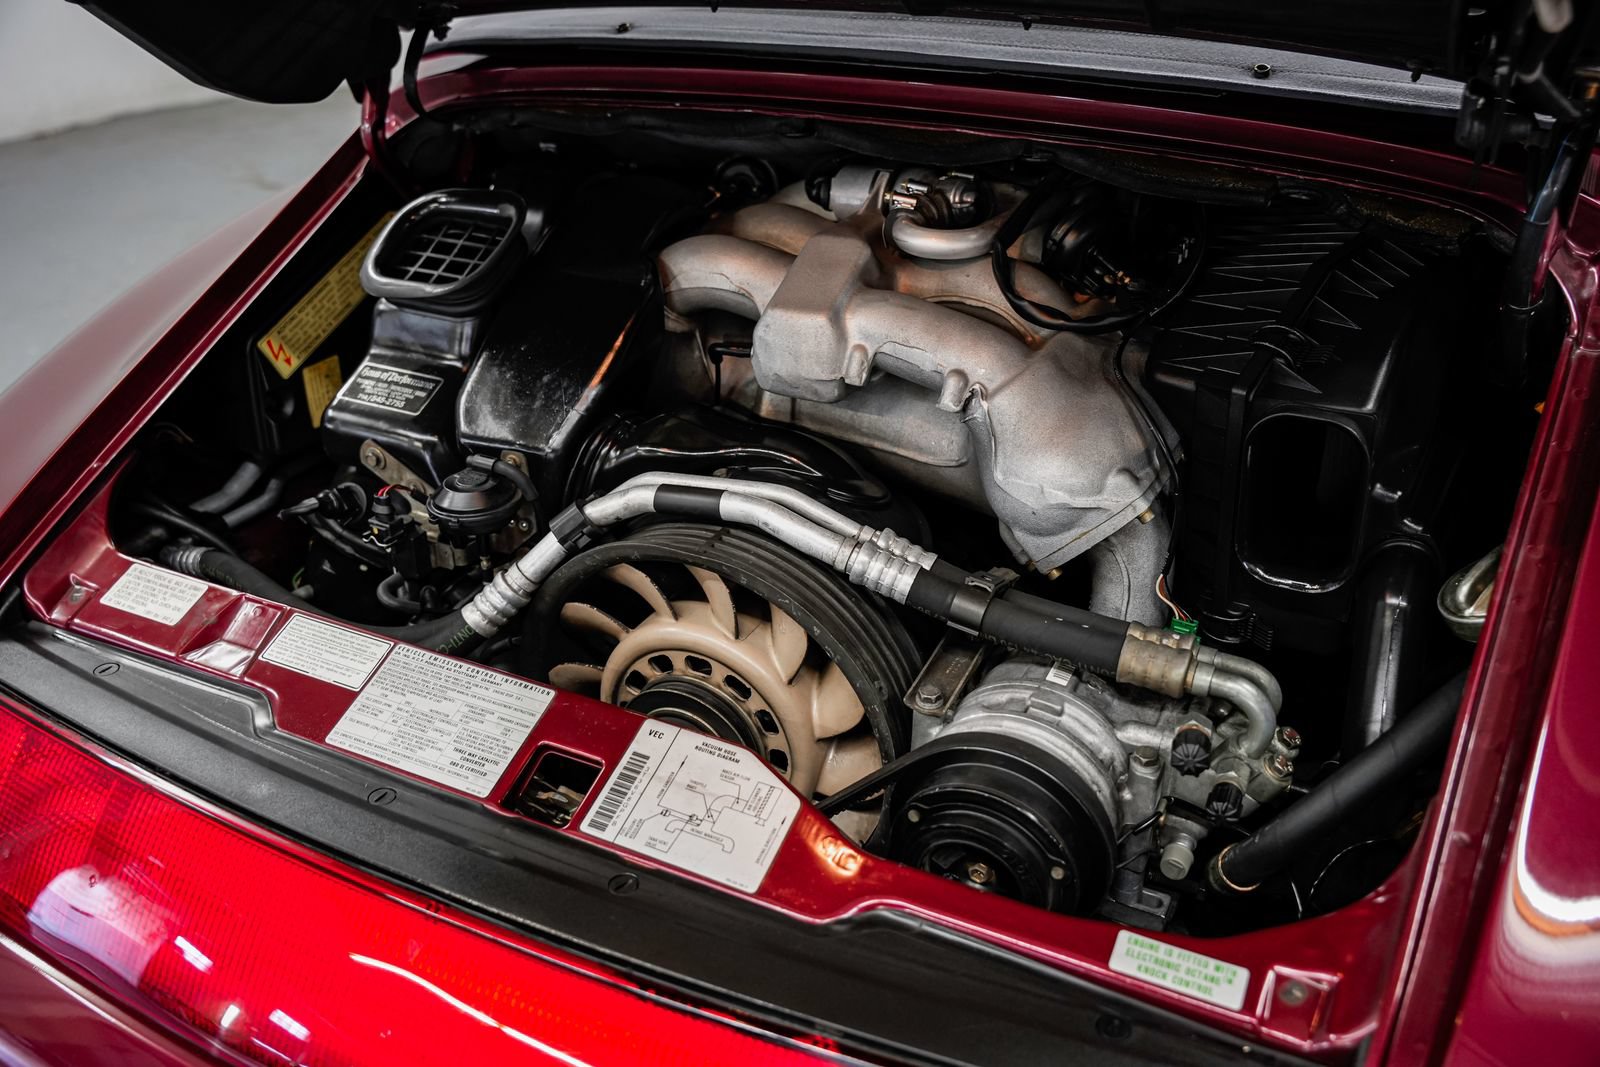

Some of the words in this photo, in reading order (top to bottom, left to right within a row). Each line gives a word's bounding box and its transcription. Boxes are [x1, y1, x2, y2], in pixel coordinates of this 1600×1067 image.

[398, 646, 426, 658] VEHICLE
[428, 655, 463, 669] EMISSION
[466, 667, 497, 680] CONTROL
[501, 678, 551, 696] INFORMATION
[424, 660, 445, 669] PORSCHE
[453, 669, 477, 679] STUTTGART
[481, 678, 502, 686] GERMANY
[649, 729, 664, 739] VEC
[695, 745, 716, 756] ROUTING
[717, 753, 740, 763] DIAGRAM
[702, 742, 723, 752] VACUUM
[453, 747, 467, 755] THREE
[478, 756, 500, 766] CATALYTIC
[460, 756, 485, 767] CONVERTER
[465, 766, 487, 777] CERTIFIED
[1128, 937, 1159, 952] ENGINE
[1126, 948, 1181, 972] ELECTRONIC
[1172, 976, 1212, 995] CONTROL
